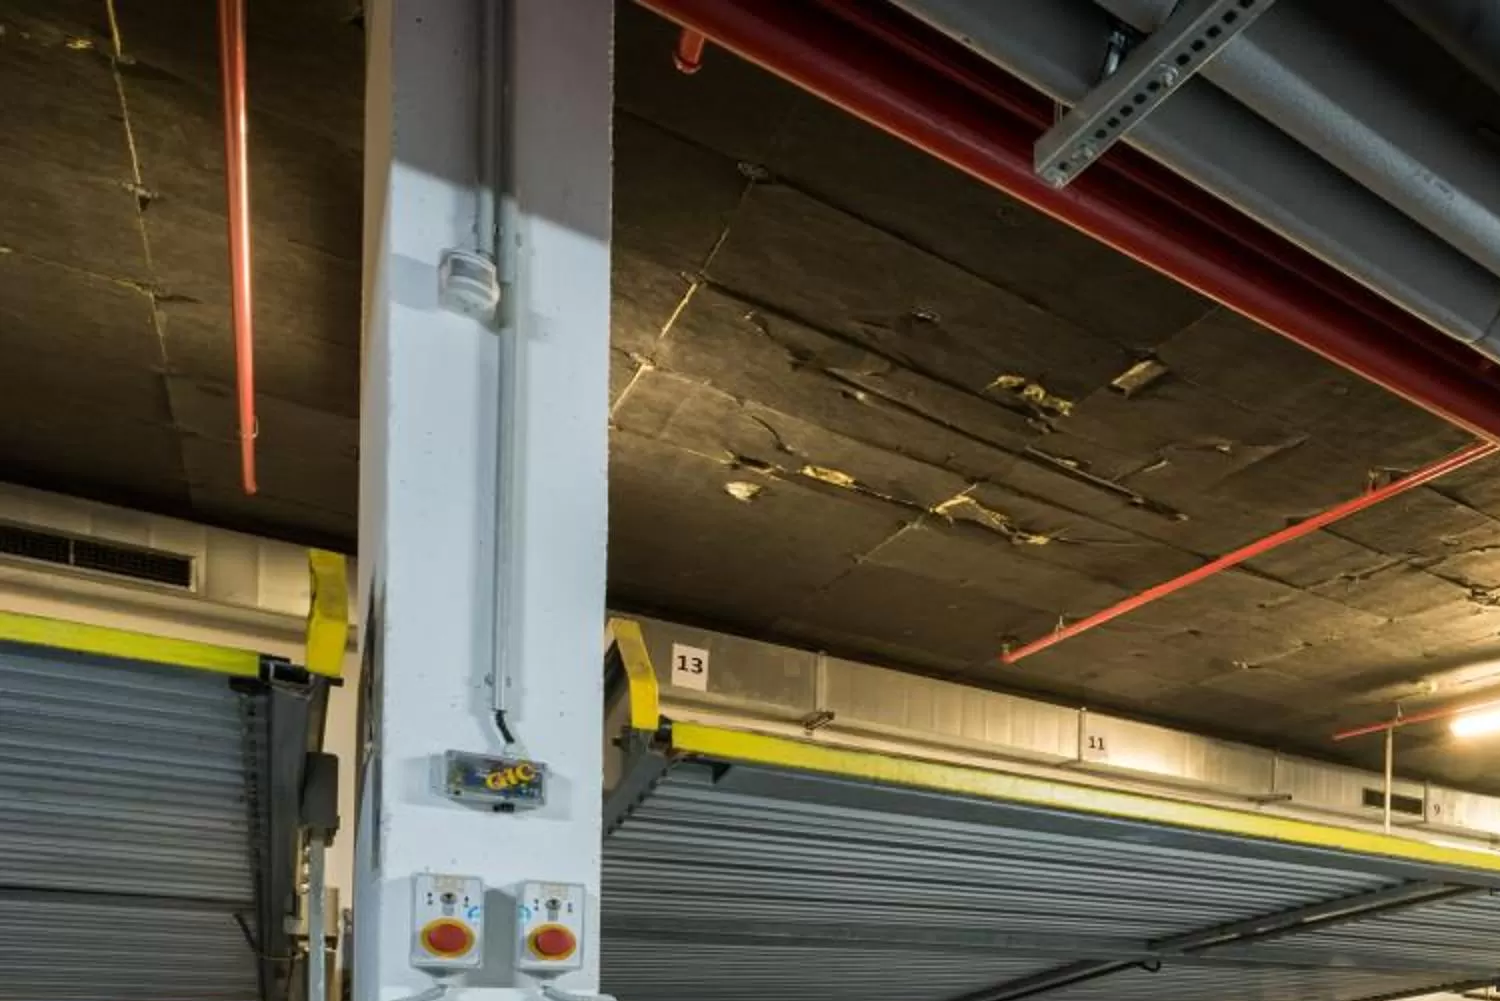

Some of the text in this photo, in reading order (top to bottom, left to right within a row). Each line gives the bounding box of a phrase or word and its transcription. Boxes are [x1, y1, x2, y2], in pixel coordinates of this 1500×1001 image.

[677, 655, 703, 675] 13
[1088, 736, 1105, 750] 11
[1433, 803, 1441, 816] 9
